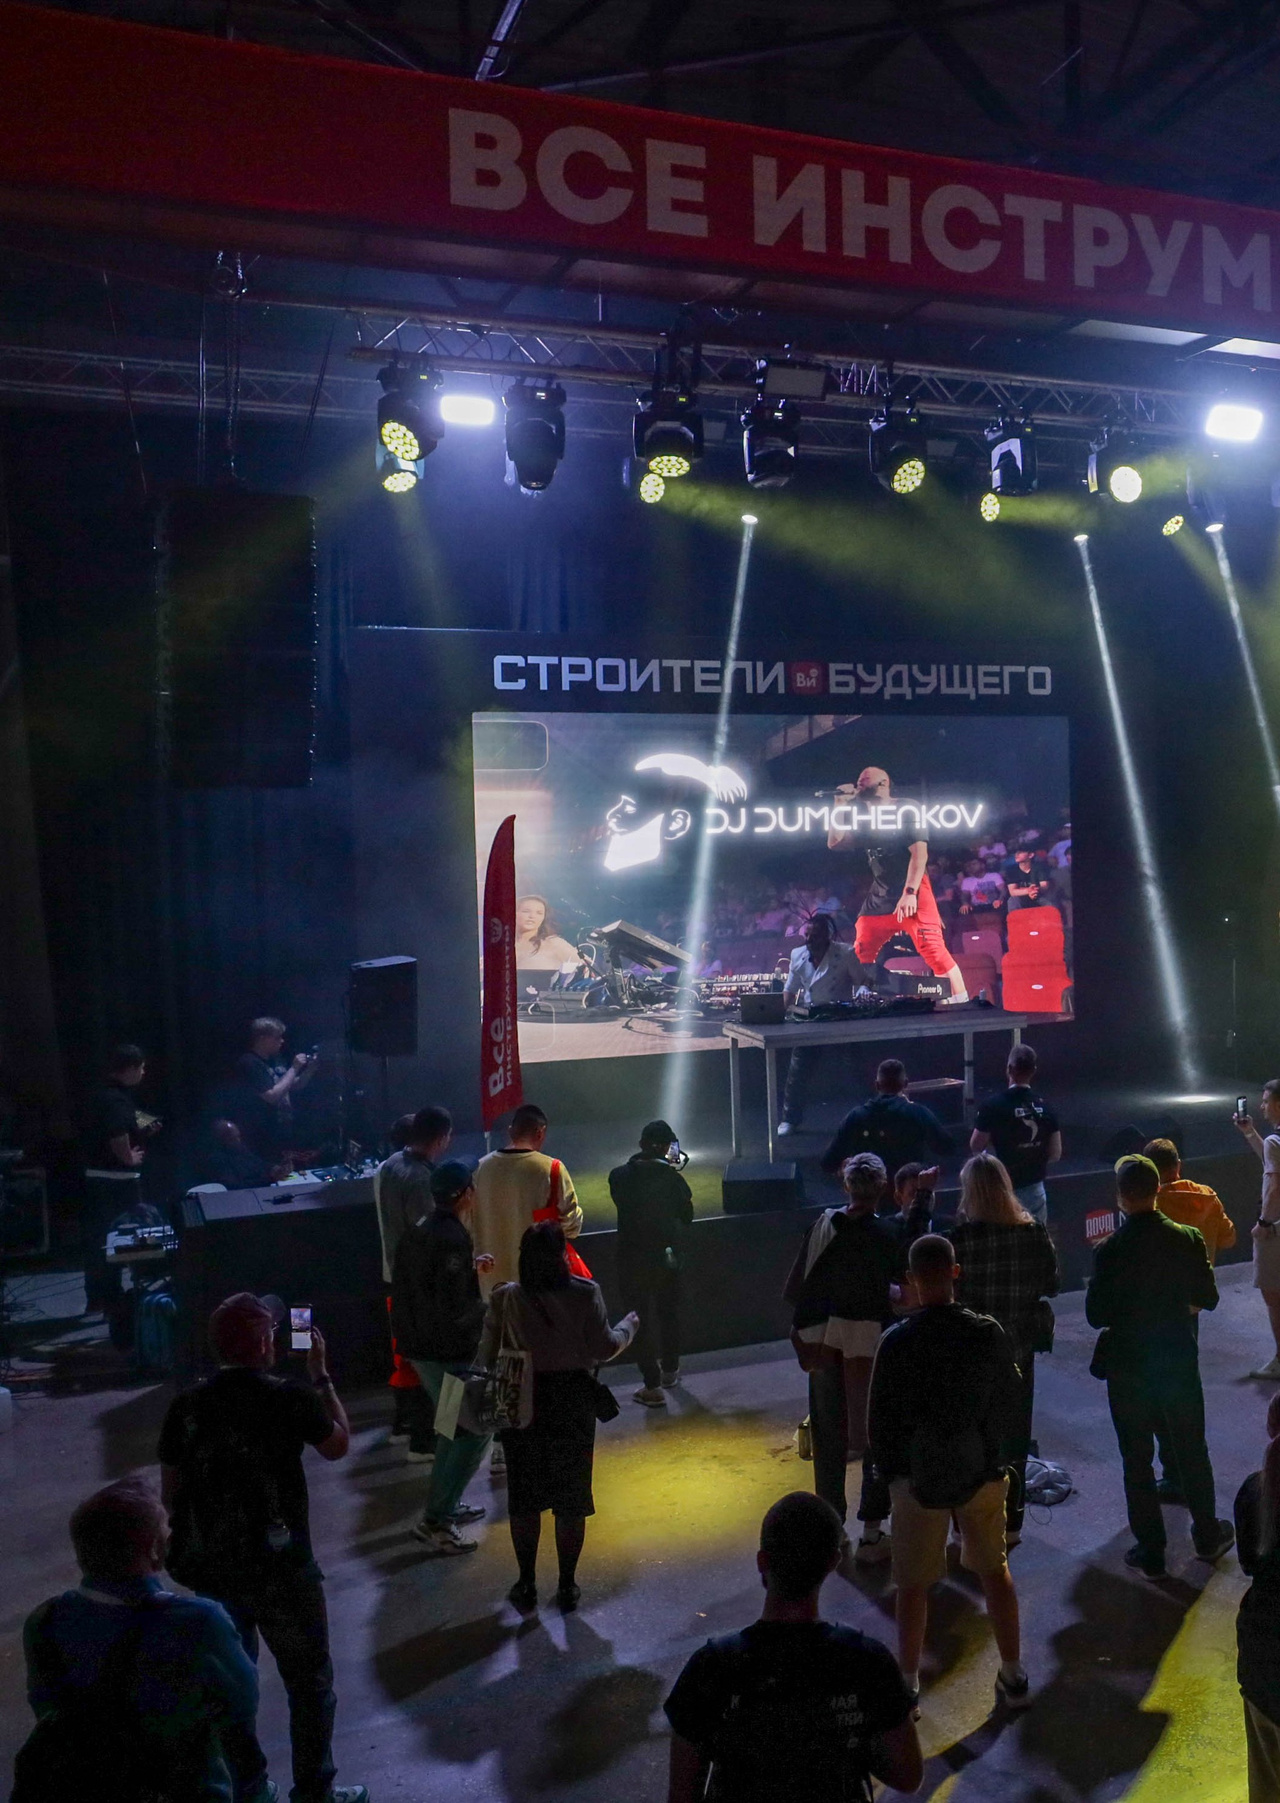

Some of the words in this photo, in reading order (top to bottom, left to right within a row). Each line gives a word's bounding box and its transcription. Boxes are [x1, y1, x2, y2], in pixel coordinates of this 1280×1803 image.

[448, 106, 709, 238] ВСЕ
[493, 655, 786, 694] СТРОИТЕЛИ
[828, 663, 1052, 700] БУДУЩЕГО
[705, 807, 746, 834] DJ
[754, 803, 983, 834] DUMCHENKOV
[488, 1017, 505, 1098] Все
[1085, 1212, 1116, 1239] ROYAL
